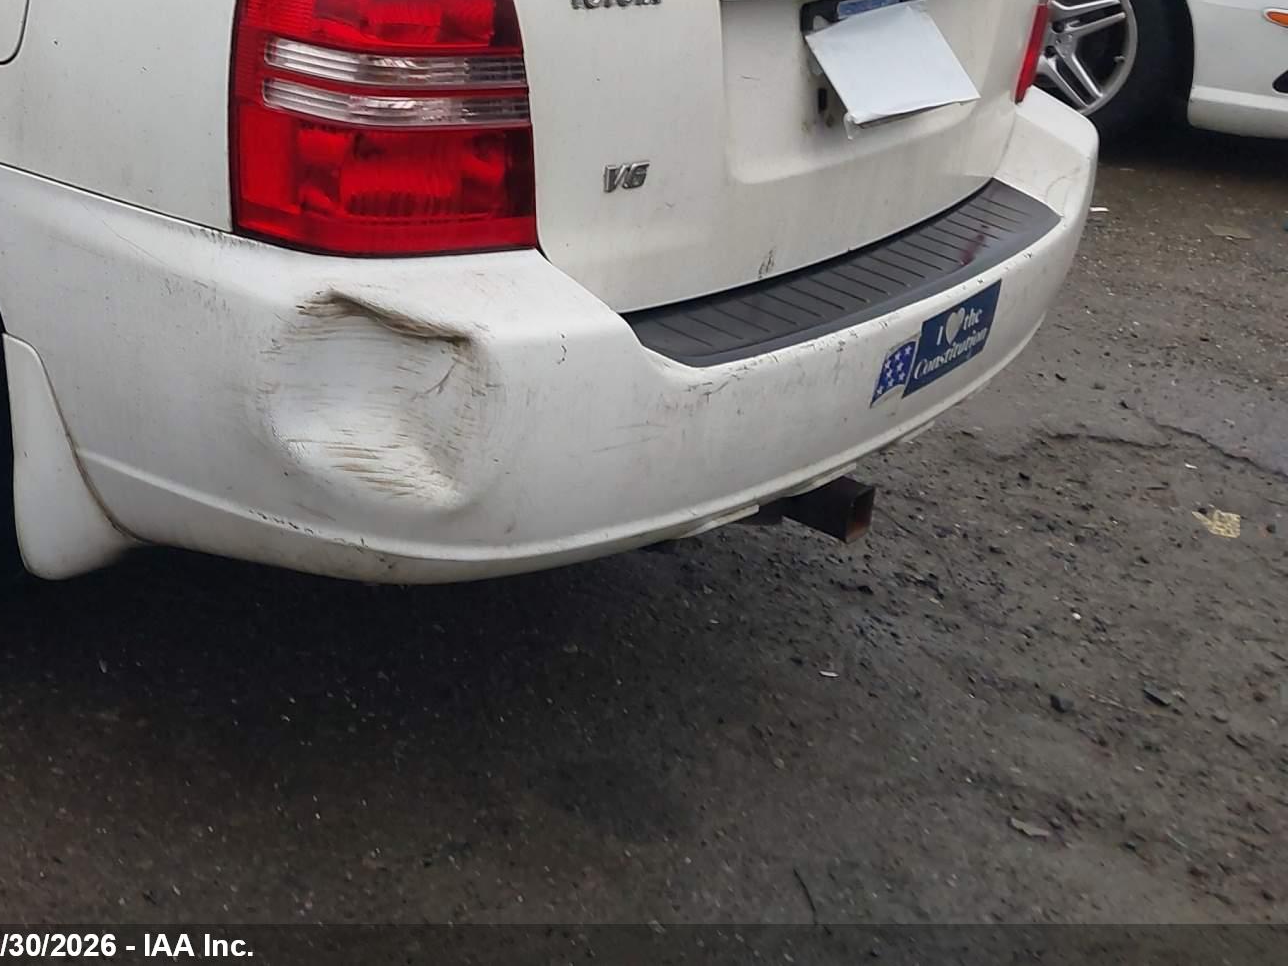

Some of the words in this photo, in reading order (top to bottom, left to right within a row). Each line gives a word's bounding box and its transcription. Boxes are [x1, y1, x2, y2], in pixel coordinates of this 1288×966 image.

[604, 160, 650, 193] V6
[936, 326, 944, 346] I
[963, 308, 983, 331] the
